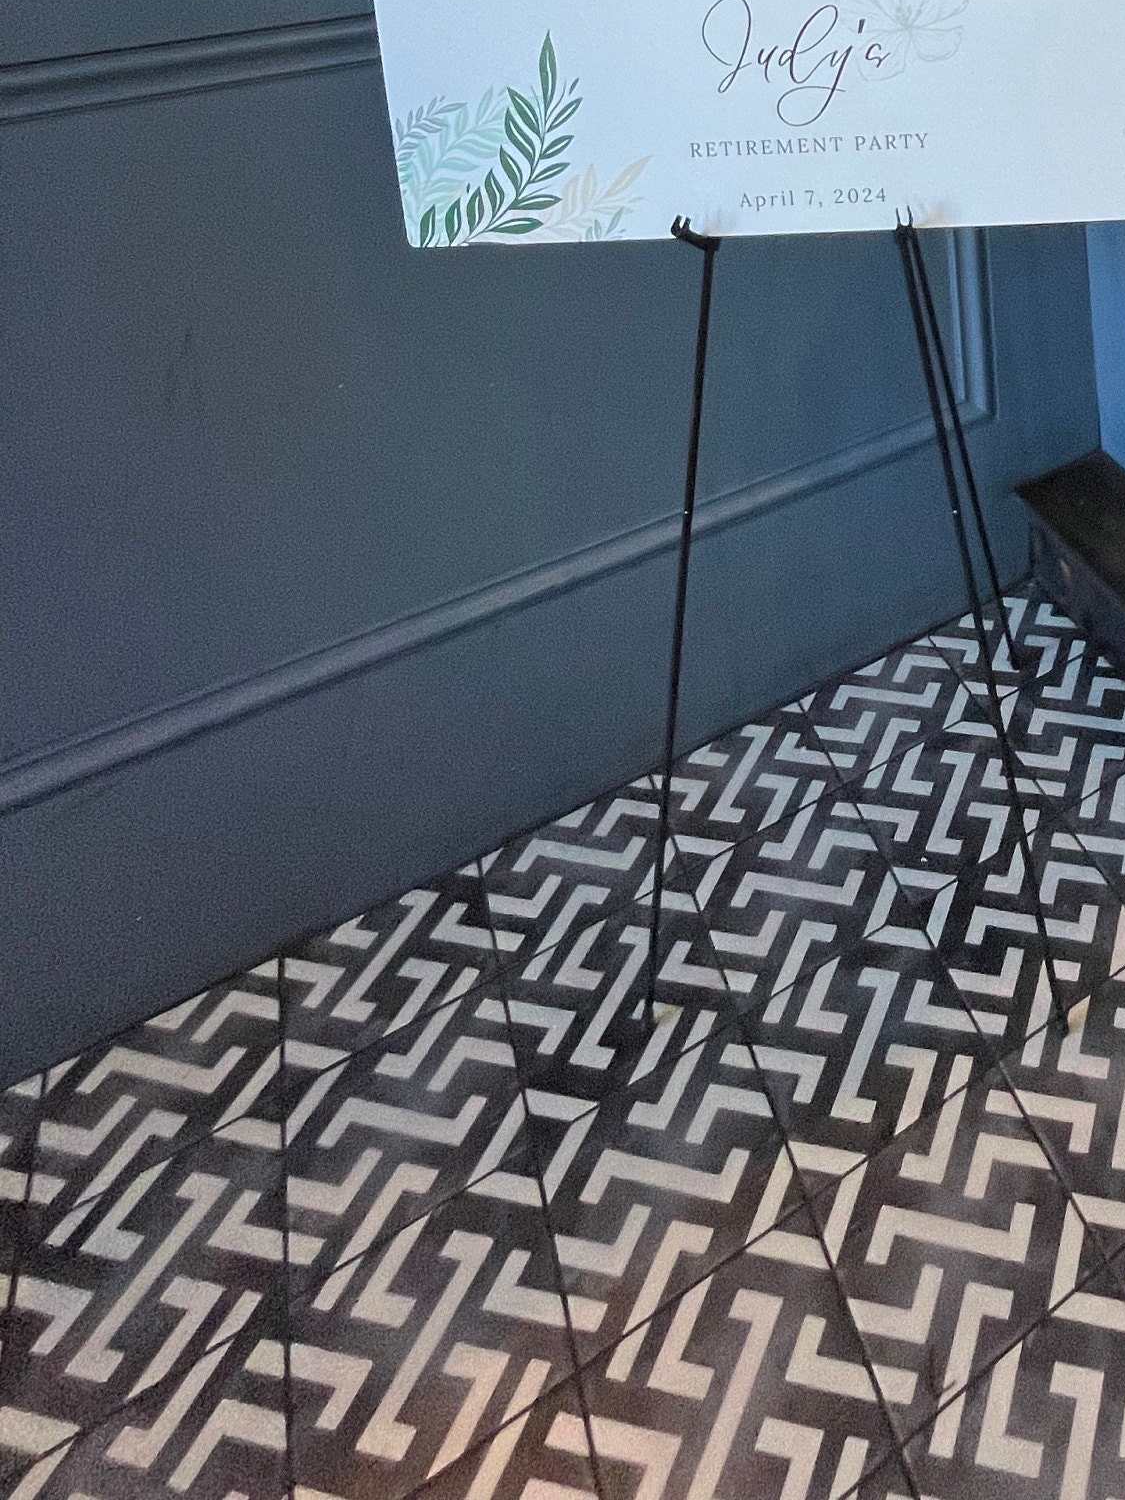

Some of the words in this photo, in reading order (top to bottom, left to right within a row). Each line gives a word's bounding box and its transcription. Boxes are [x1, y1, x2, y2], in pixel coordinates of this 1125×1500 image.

[689, 136, 844, 158] RETIREMENT
[854, 132, 929, 152] PARTY
[739, 189, 795, 212] April
[804, 189, 823, 208] 7,
[833, 187, 888, 205] 2024
